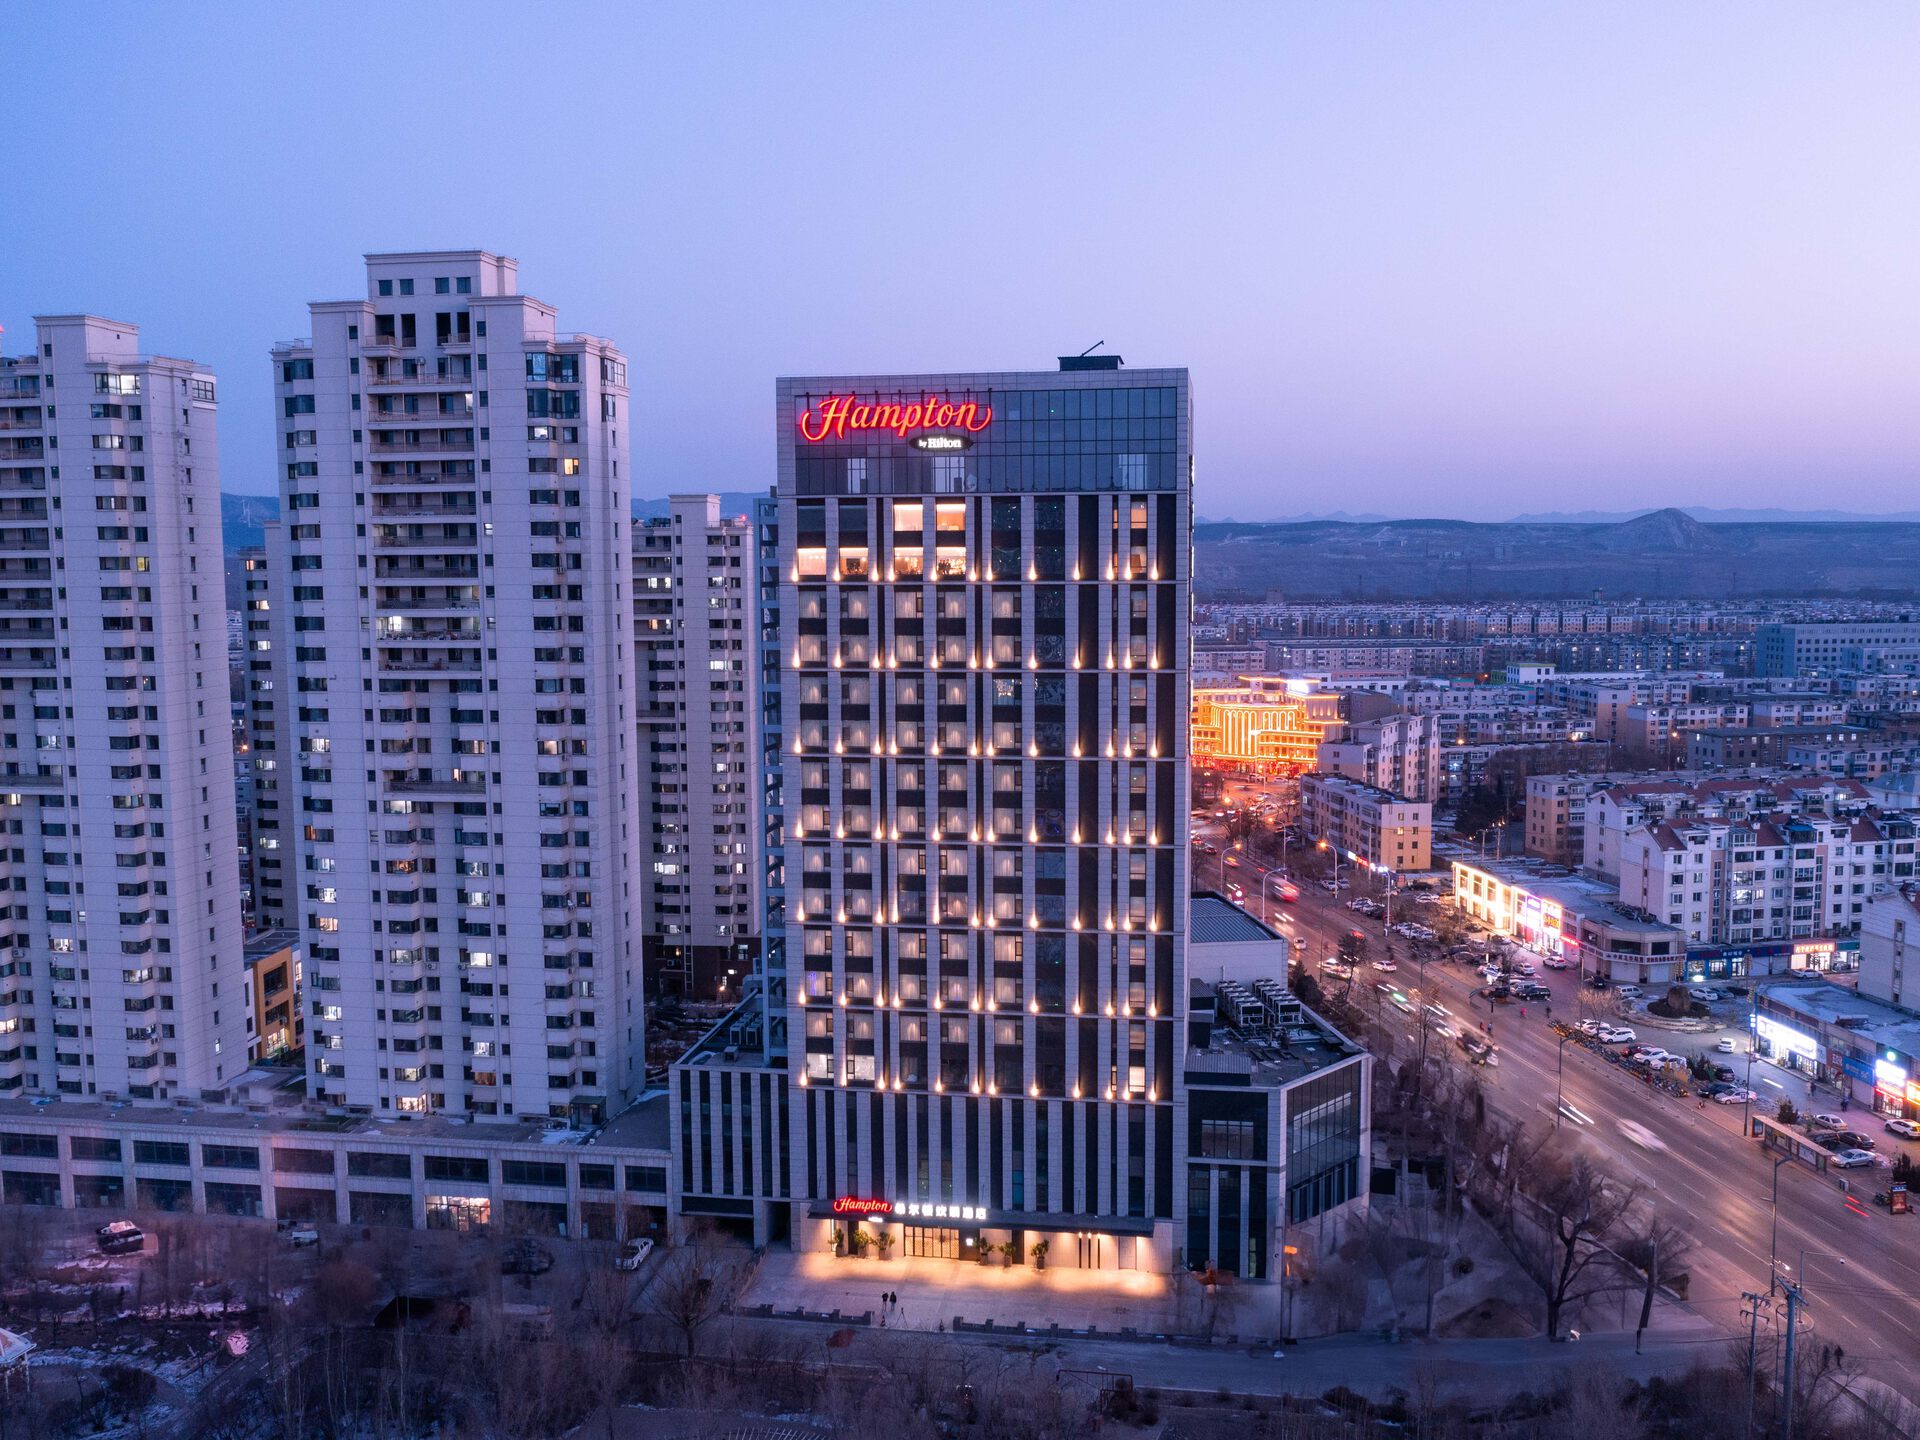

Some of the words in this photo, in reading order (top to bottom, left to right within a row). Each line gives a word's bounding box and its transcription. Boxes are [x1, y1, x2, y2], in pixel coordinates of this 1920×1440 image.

[801, 394, 993, 442] Hampton
[918, 439, 927, 449] by
[927, 437, 962, 449] Hilton
[833, 1197, 893, 1214] Hampton
